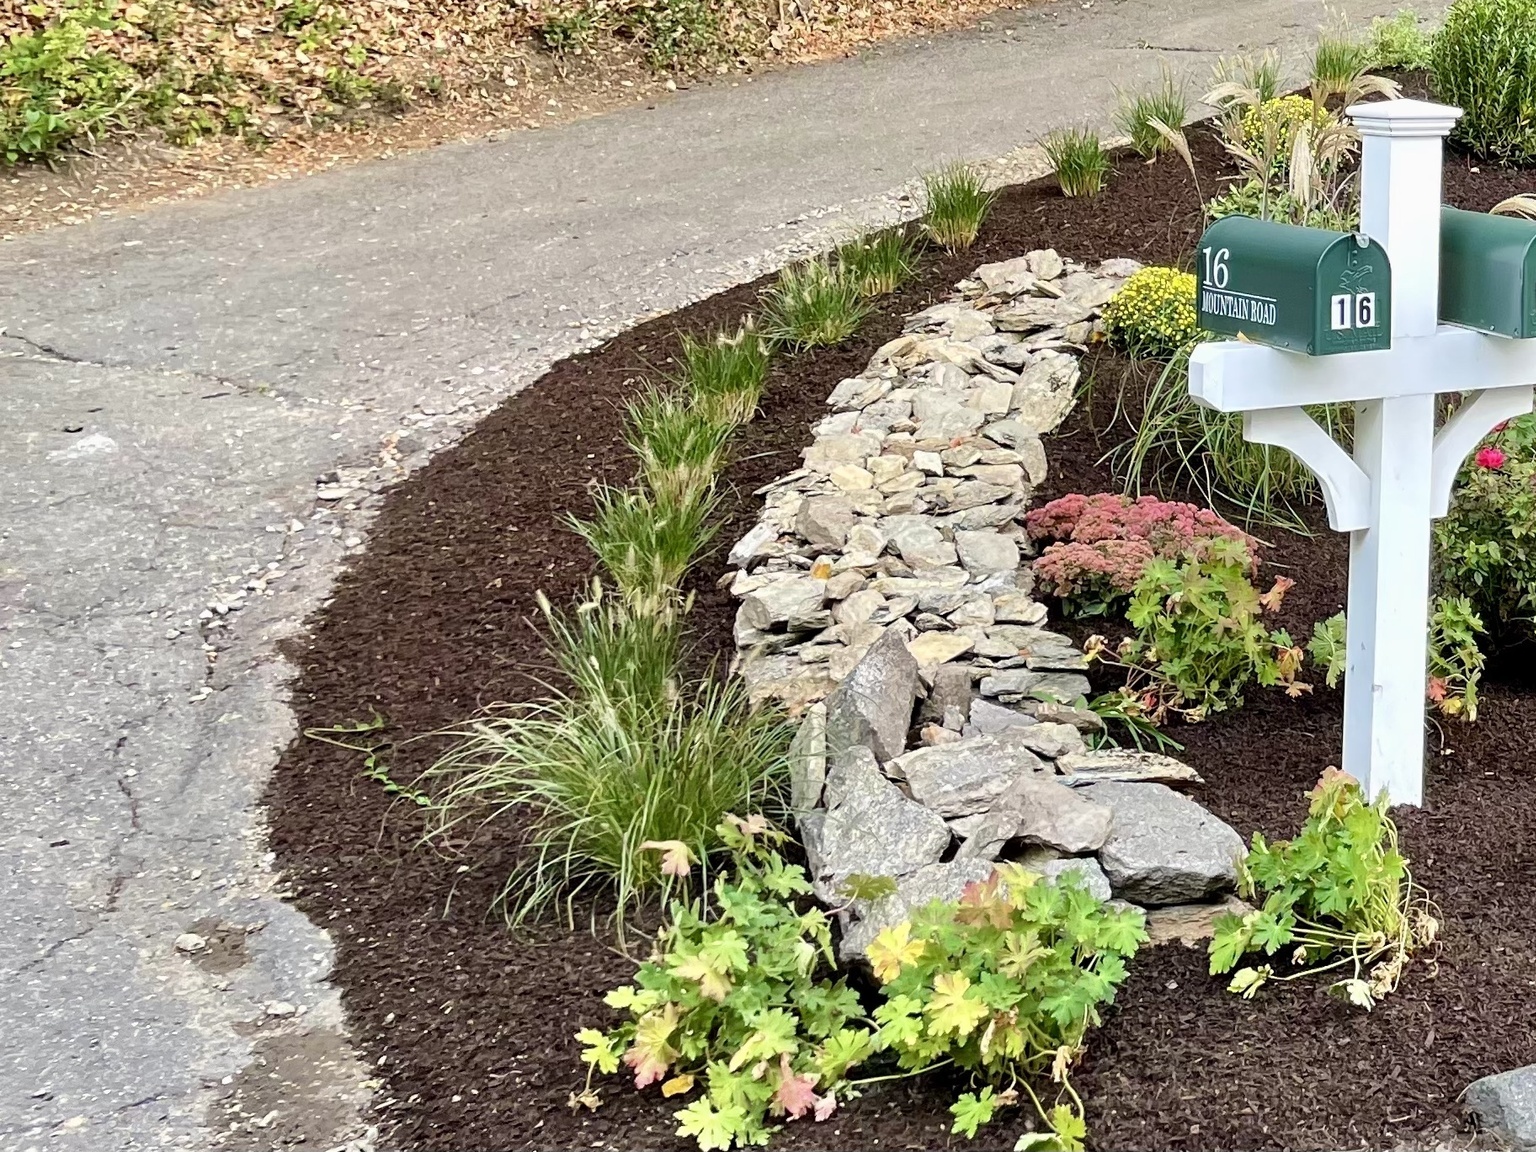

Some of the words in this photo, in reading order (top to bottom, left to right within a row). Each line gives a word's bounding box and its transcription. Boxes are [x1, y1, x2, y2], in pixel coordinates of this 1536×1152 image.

[1203, 247, 1229, 288] 16
[1201, 291, 1249, 320] MOUNTAIN
[1250, 300, 1276, 325] ROAD
[1337, 296, 1371, 325] 16
